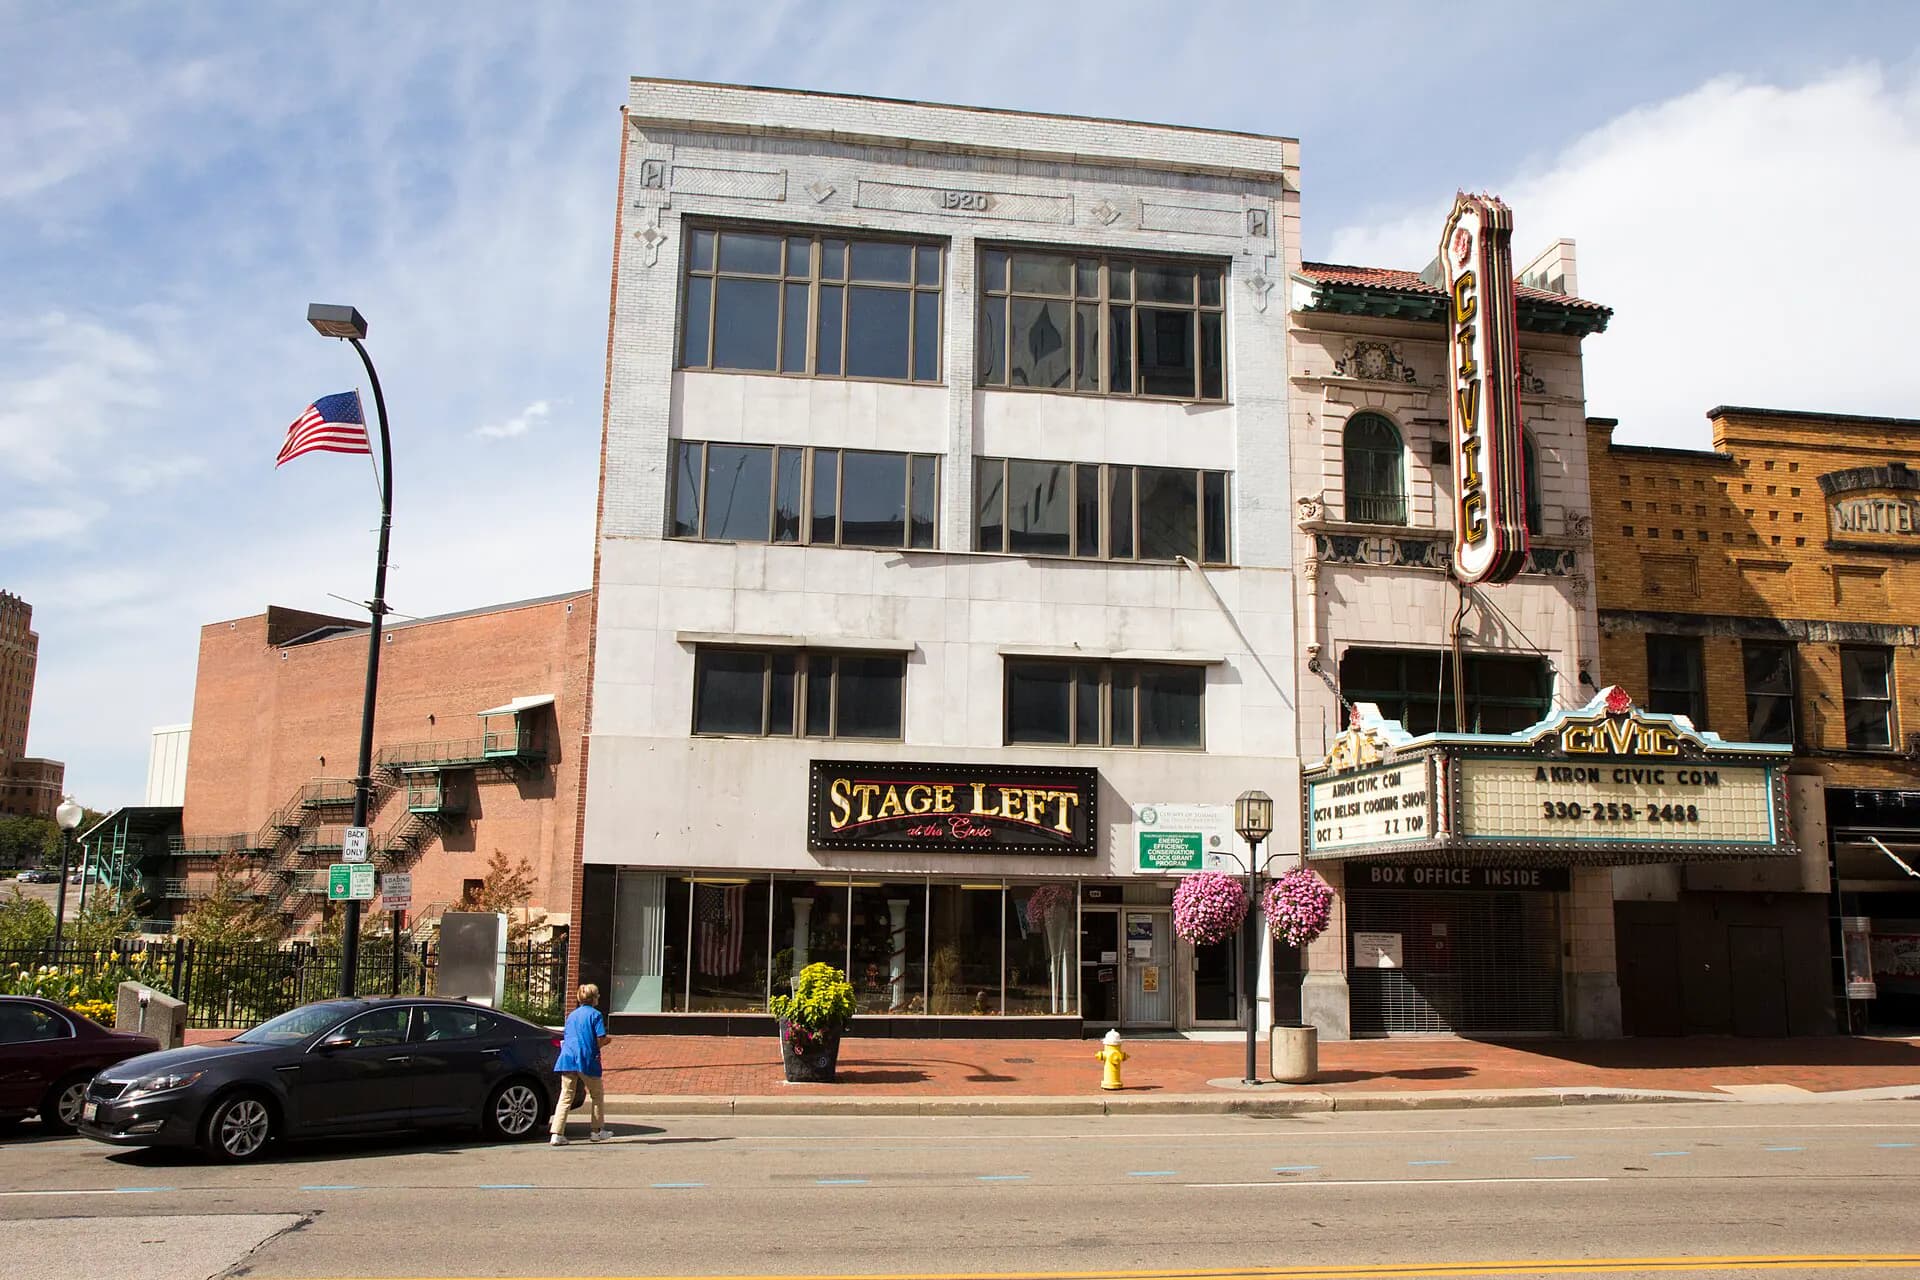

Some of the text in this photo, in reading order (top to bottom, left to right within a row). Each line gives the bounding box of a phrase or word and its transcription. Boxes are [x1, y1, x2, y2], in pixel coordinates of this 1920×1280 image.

[941, 191, 989, 211] 1920
[1454, 270, 1488, 545] CIVIC
[1562, 718, 1679, 756] CIVIC
[1333, 771, 1401, 798] AKRON CIVIC COM
[1535, 766, 1719, 786] AKRON CIVIC COM
[829, 777, 1079, 834] STAGE LEFT
[1335, 801, 1360, 819] RELISH
[1363, 795, 1398, 814] COOKING
[906, 816, 993, 839] at the Civic
[1317, 828, 1332, 842] OCT
[1338, 826, 1343, 840] 3
[1405, 815, 1423, 832] TOP
[1371, 867, 1541, 886] BOX OFFICE INSIDE
